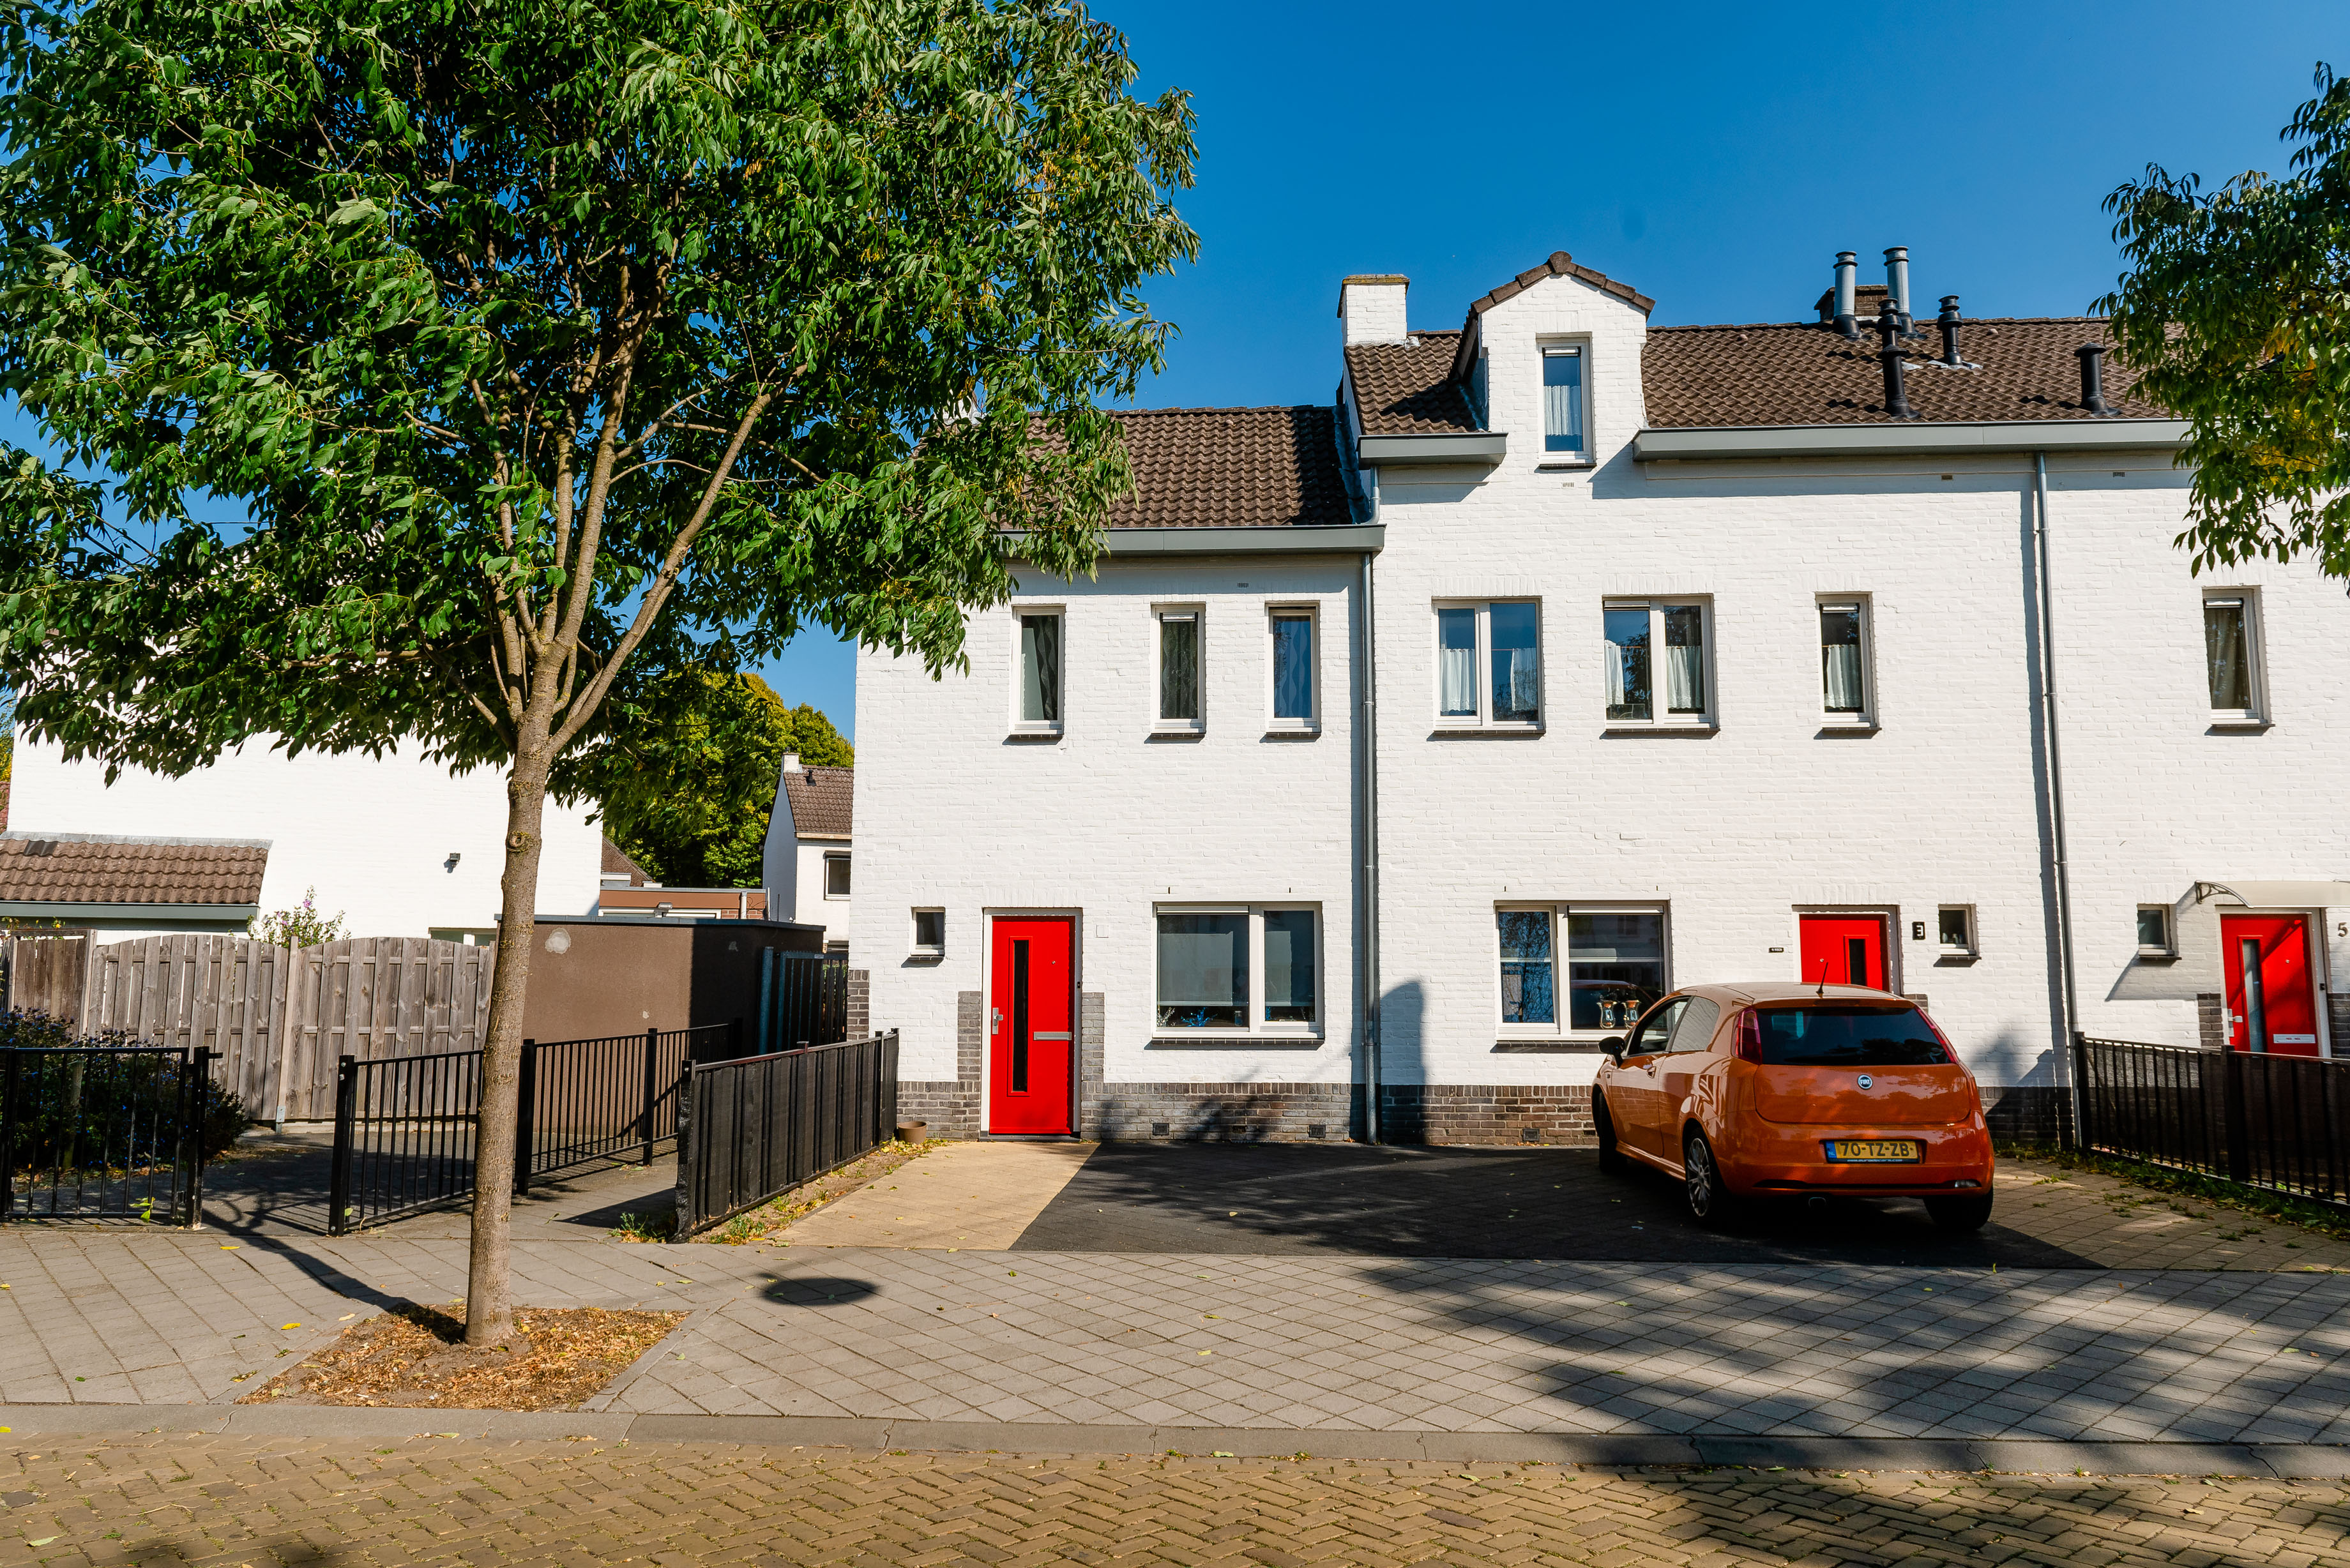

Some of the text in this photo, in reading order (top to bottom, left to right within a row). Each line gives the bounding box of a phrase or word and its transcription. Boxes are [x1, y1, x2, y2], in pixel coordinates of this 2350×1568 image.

[1916, 925, 1923, 937] 3
[2338, 922, 2348, 937] 5
[1840, 1143, 1909, 1156] 70-TZ-ZB
